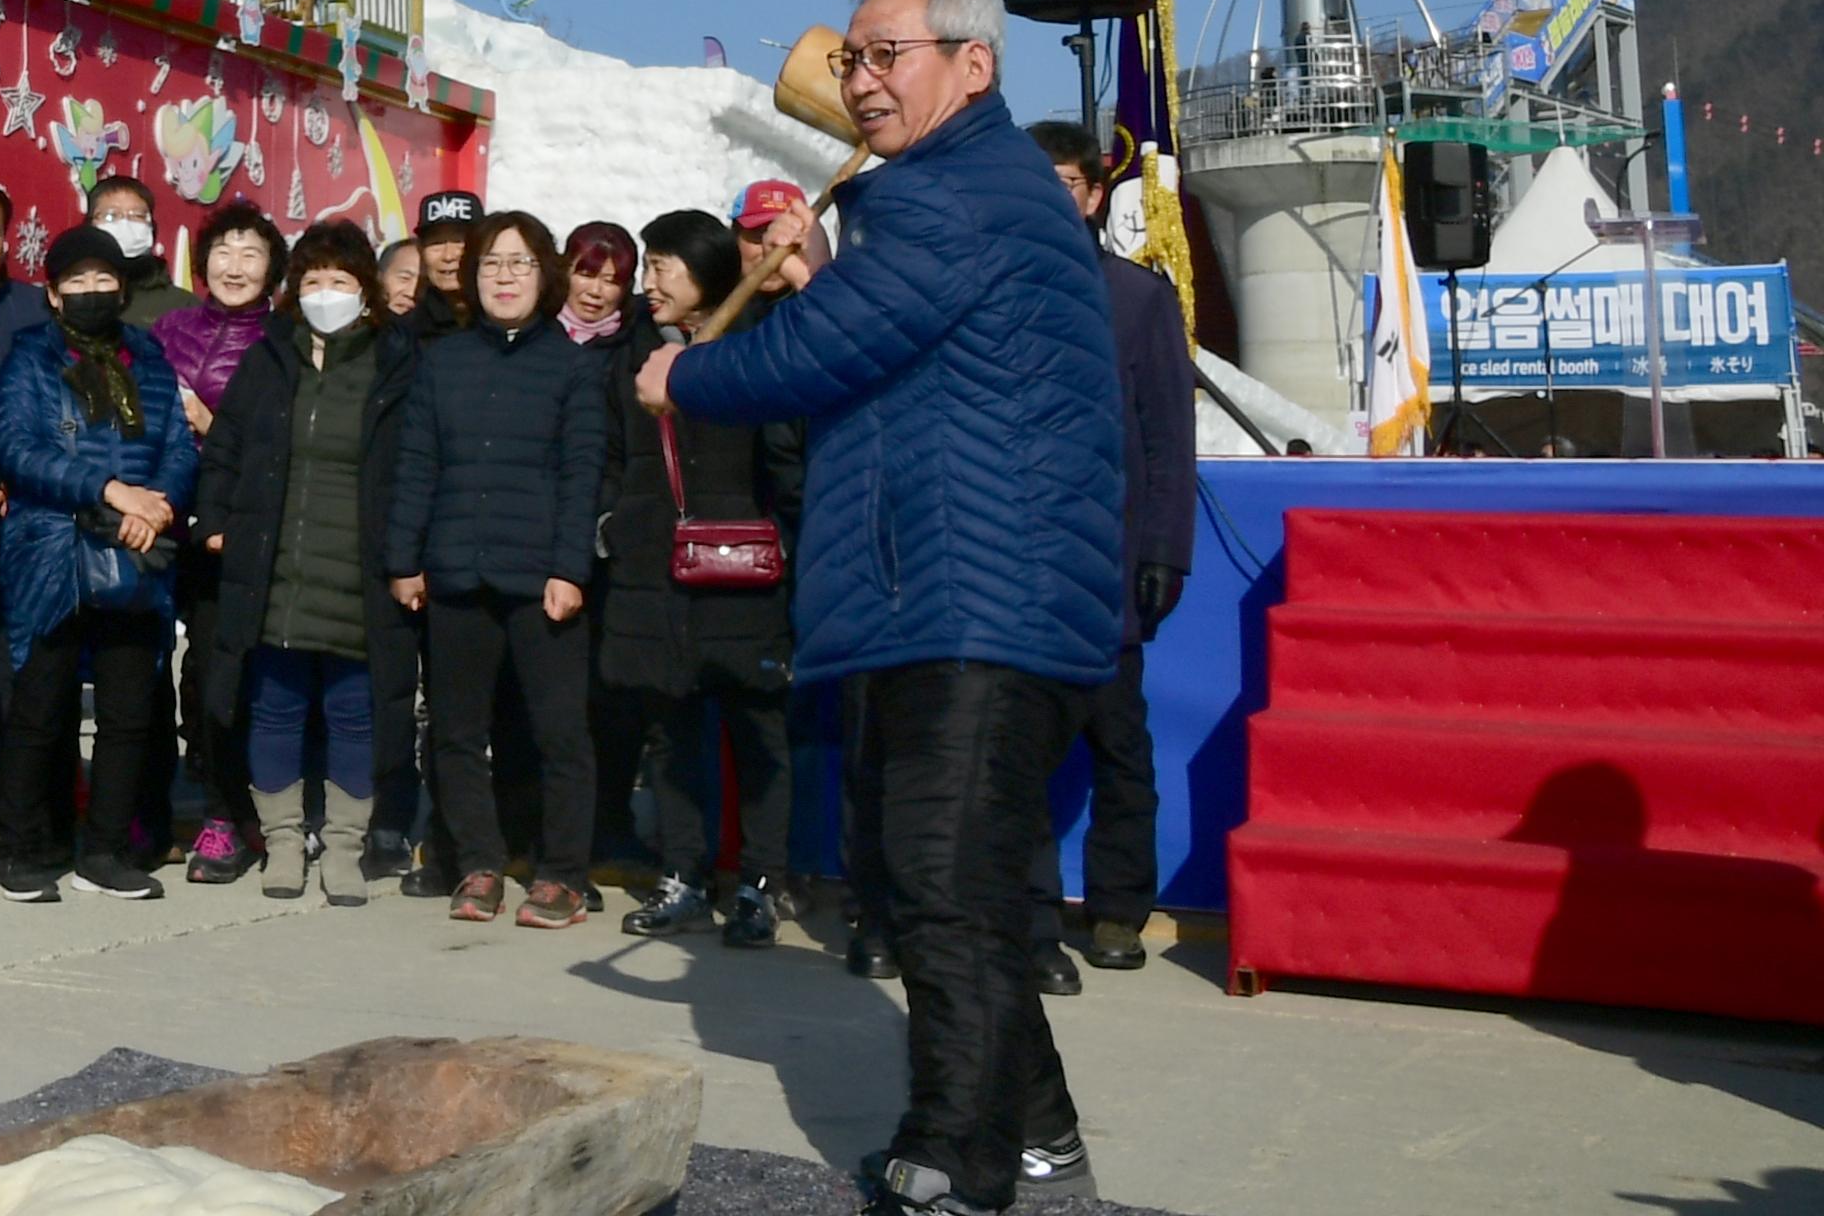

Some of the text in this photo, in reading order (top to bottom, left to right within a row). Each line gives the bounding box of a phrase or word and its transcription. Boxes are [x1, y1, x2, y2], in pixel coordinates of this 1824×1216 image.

[1440, 281, 1770, 350] 얼음썰매 대여
[1458, 360, 1477, 376] ce
[1479, 358, 1511, 376] sled
[1558, 358, 1600, 375] booth
